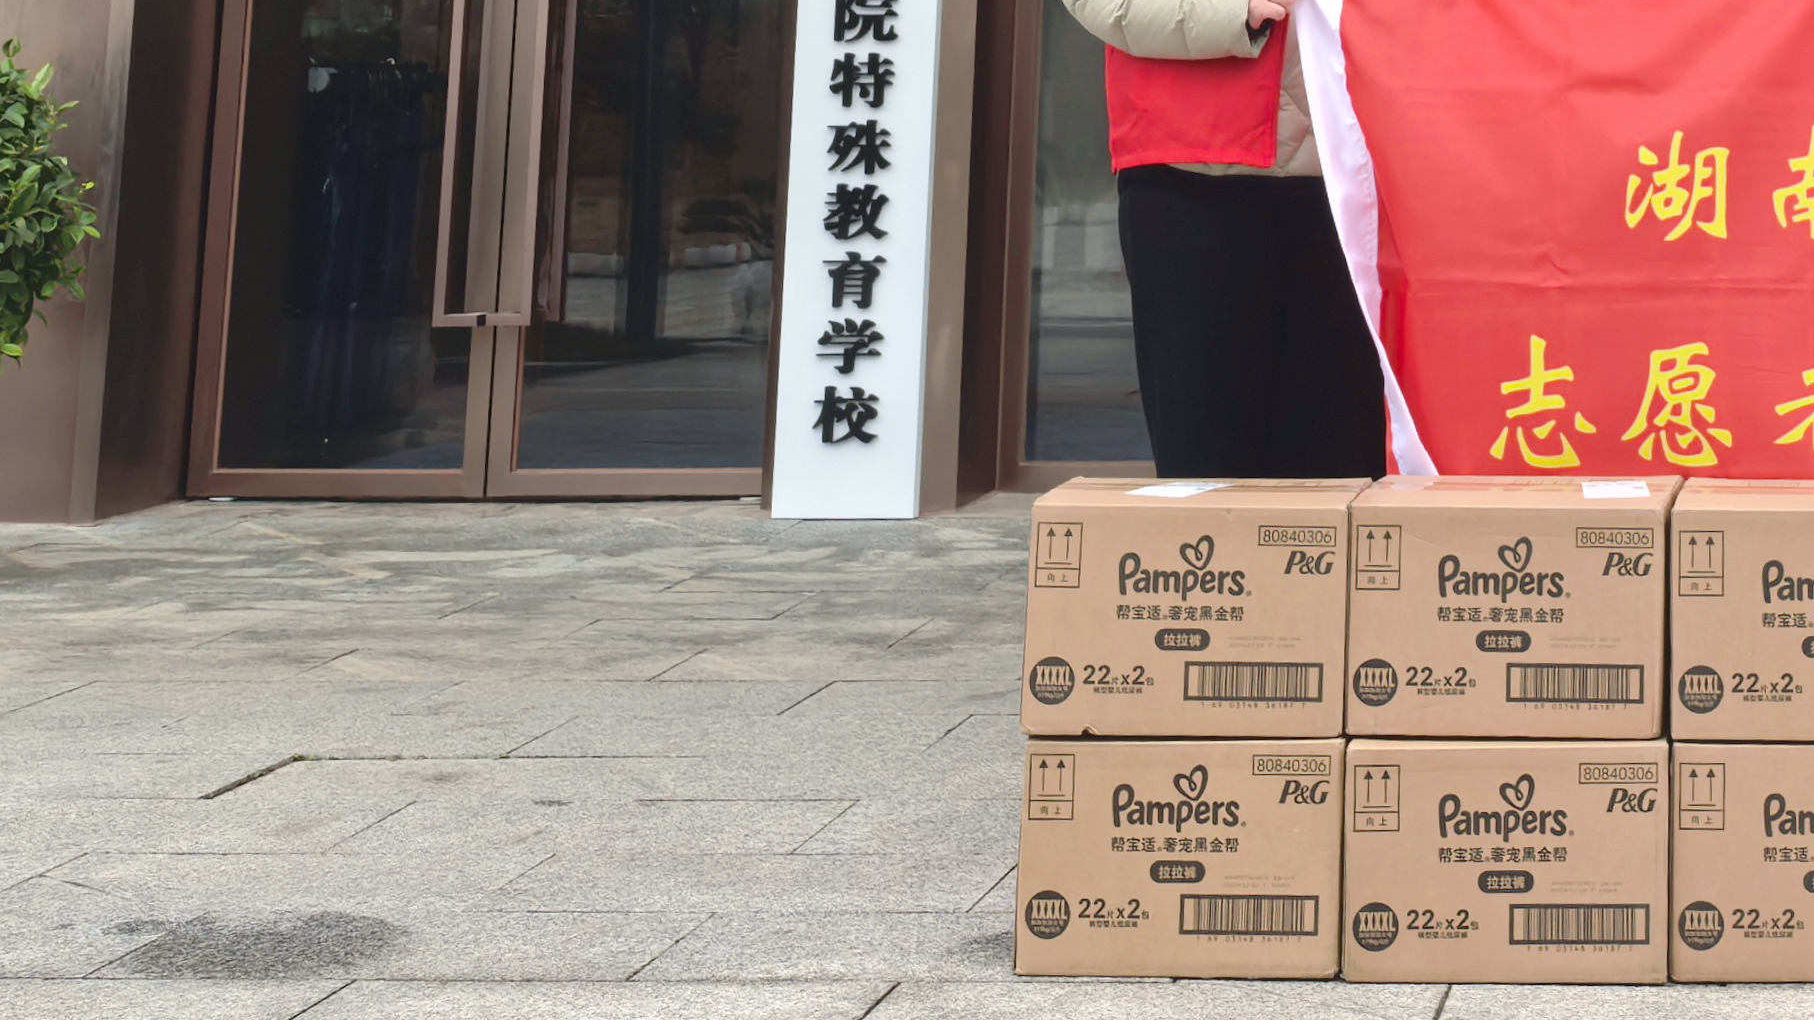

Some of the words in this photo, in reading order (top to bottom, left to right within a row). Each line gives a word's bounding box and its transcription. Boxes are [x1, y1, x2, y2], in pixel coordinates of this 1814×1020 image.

[1262, 529, 1332, 543] 80840306
[1580, 531, 1649, 545] 80840306
[1284, 550, 1336, 575] P&G
[1602, 552, 1653, 576] P&G
[1117, 552, 1247, 602] Pampers
[1437, 554, 1565, 603] Pampers
[1035, 665, 1073, 685] XXXXL
[1359, 667, 1395, 687] XXXXL
[1684, 674, 1721, 694] XXXXL
[1256, 758, 1327, 772] 80840306
[1583, 766, 1654, 781] 80840306
[1278, 780, 1331, 804] P&G
[1606, 788, 1658, 813] P&G
[1111, 783, 1241, 833] Pampers
[1438, 792, 1568, 843] Pampers
[1030, 899, 1068, 919] XXXXL
[1359, 911, 1396, 931] XXXXL
[1684, 910, 1721, 930] XXXXL
